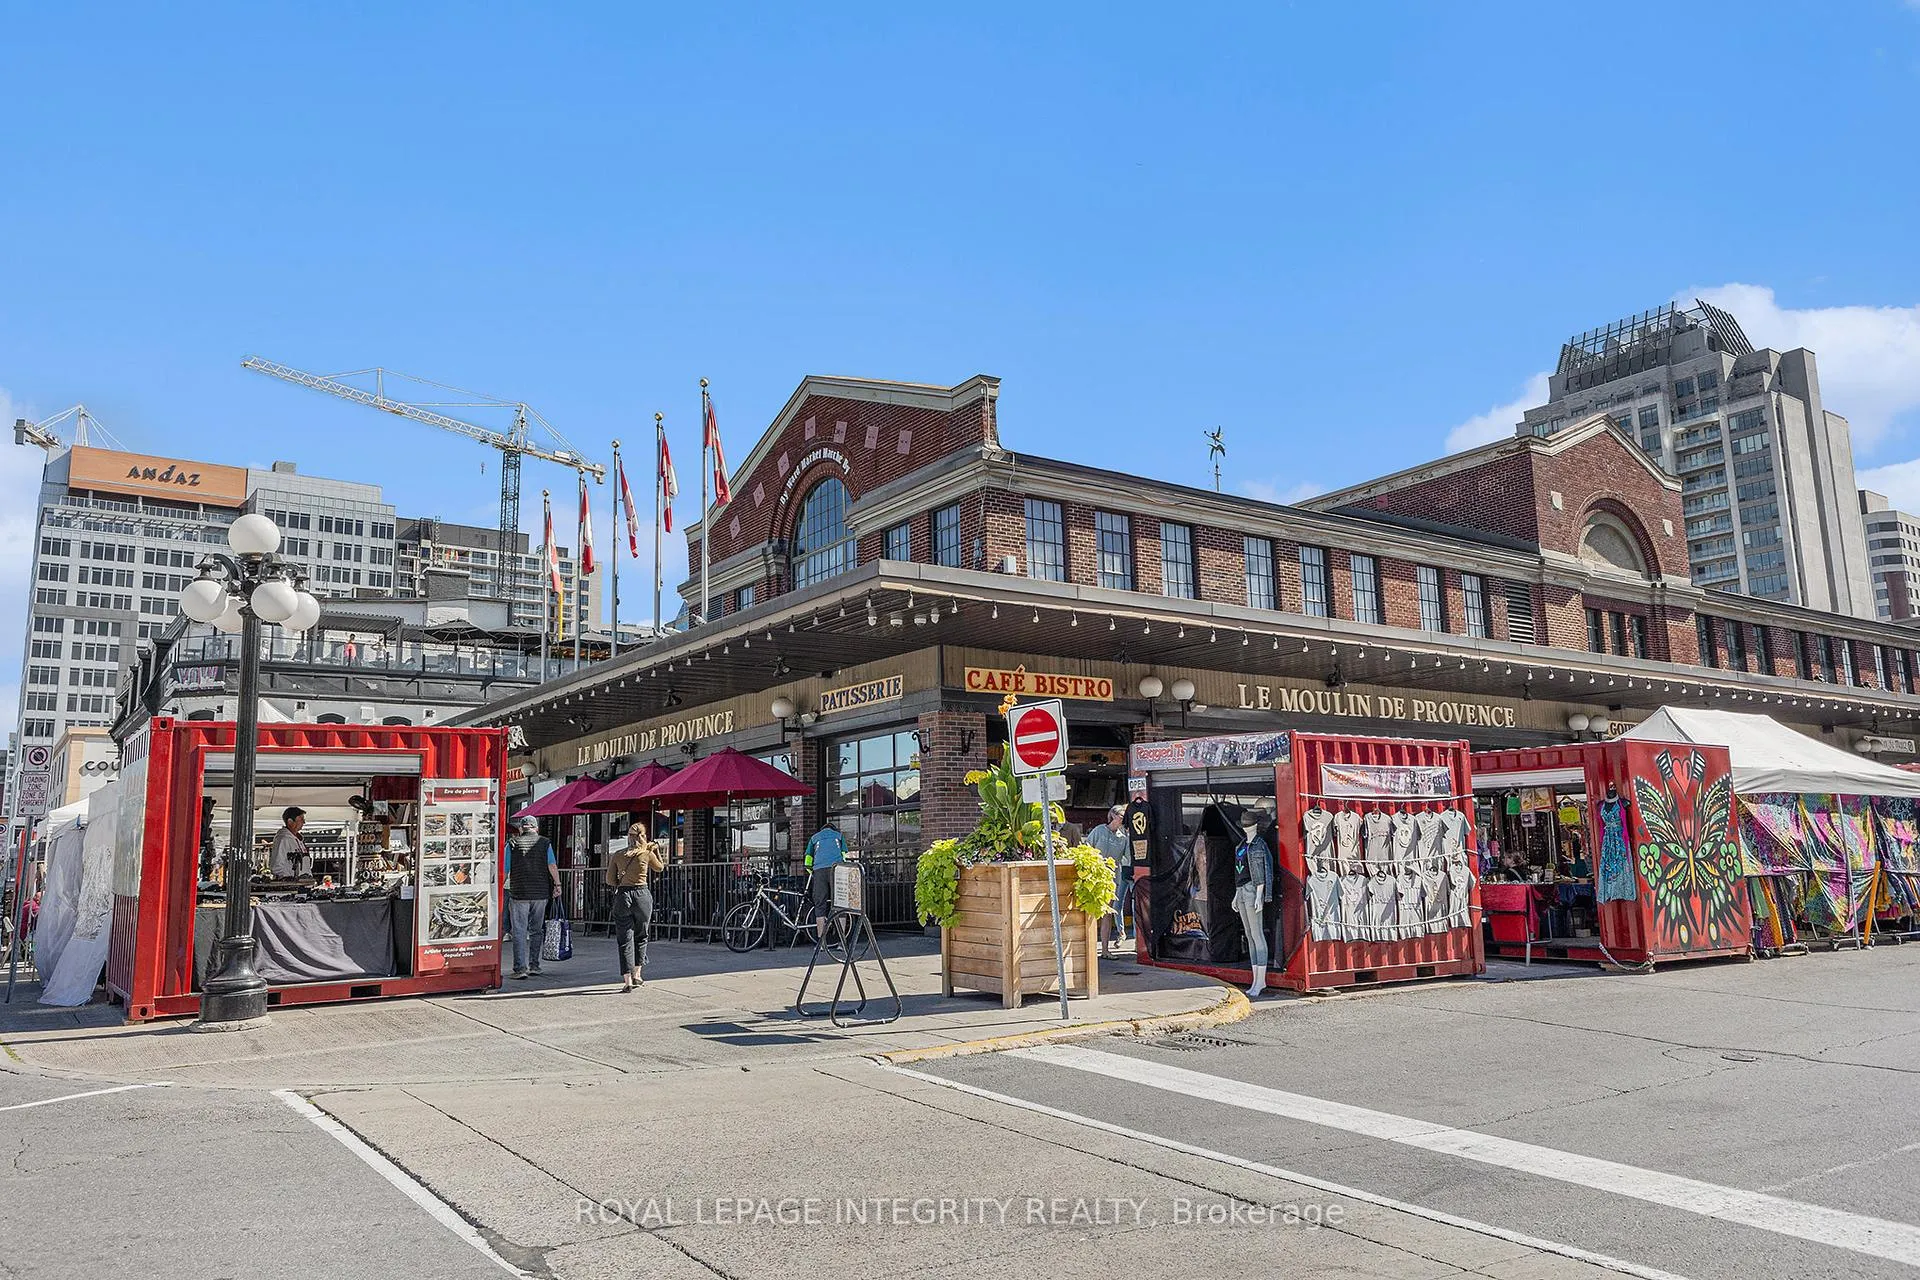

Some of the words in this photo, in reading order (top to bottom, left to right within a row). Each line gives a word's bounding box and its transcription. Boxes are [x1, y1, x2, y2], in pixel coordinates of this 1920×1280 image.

[786, 465, 801, 489] Ward
[801, 449, 822, 470] Market
[821, 677, 901, 711] PATISSERIE
[967, 667, 1026, 693] CAFÉ
[1034, 675, 1111, 698] BISTRO
[1237, 683, 1272, 710] LE
[1279, 687, 1372, 718] MOULIN
[1378, 696, 1406, 719] DE
[1412, 699, 1516, 728] PROVENCE
[577, 746, 591, 766] LE
[593, 732, 638, 763] MOULIN
[640, 728, 657, 752] DE
[660, 710, 734, 747] PROVENCE
[22, 791, 36, 799] ZONE
[27, 783, 42, 791] ZONE
[1129, 780, 1146, 790] OPEN
